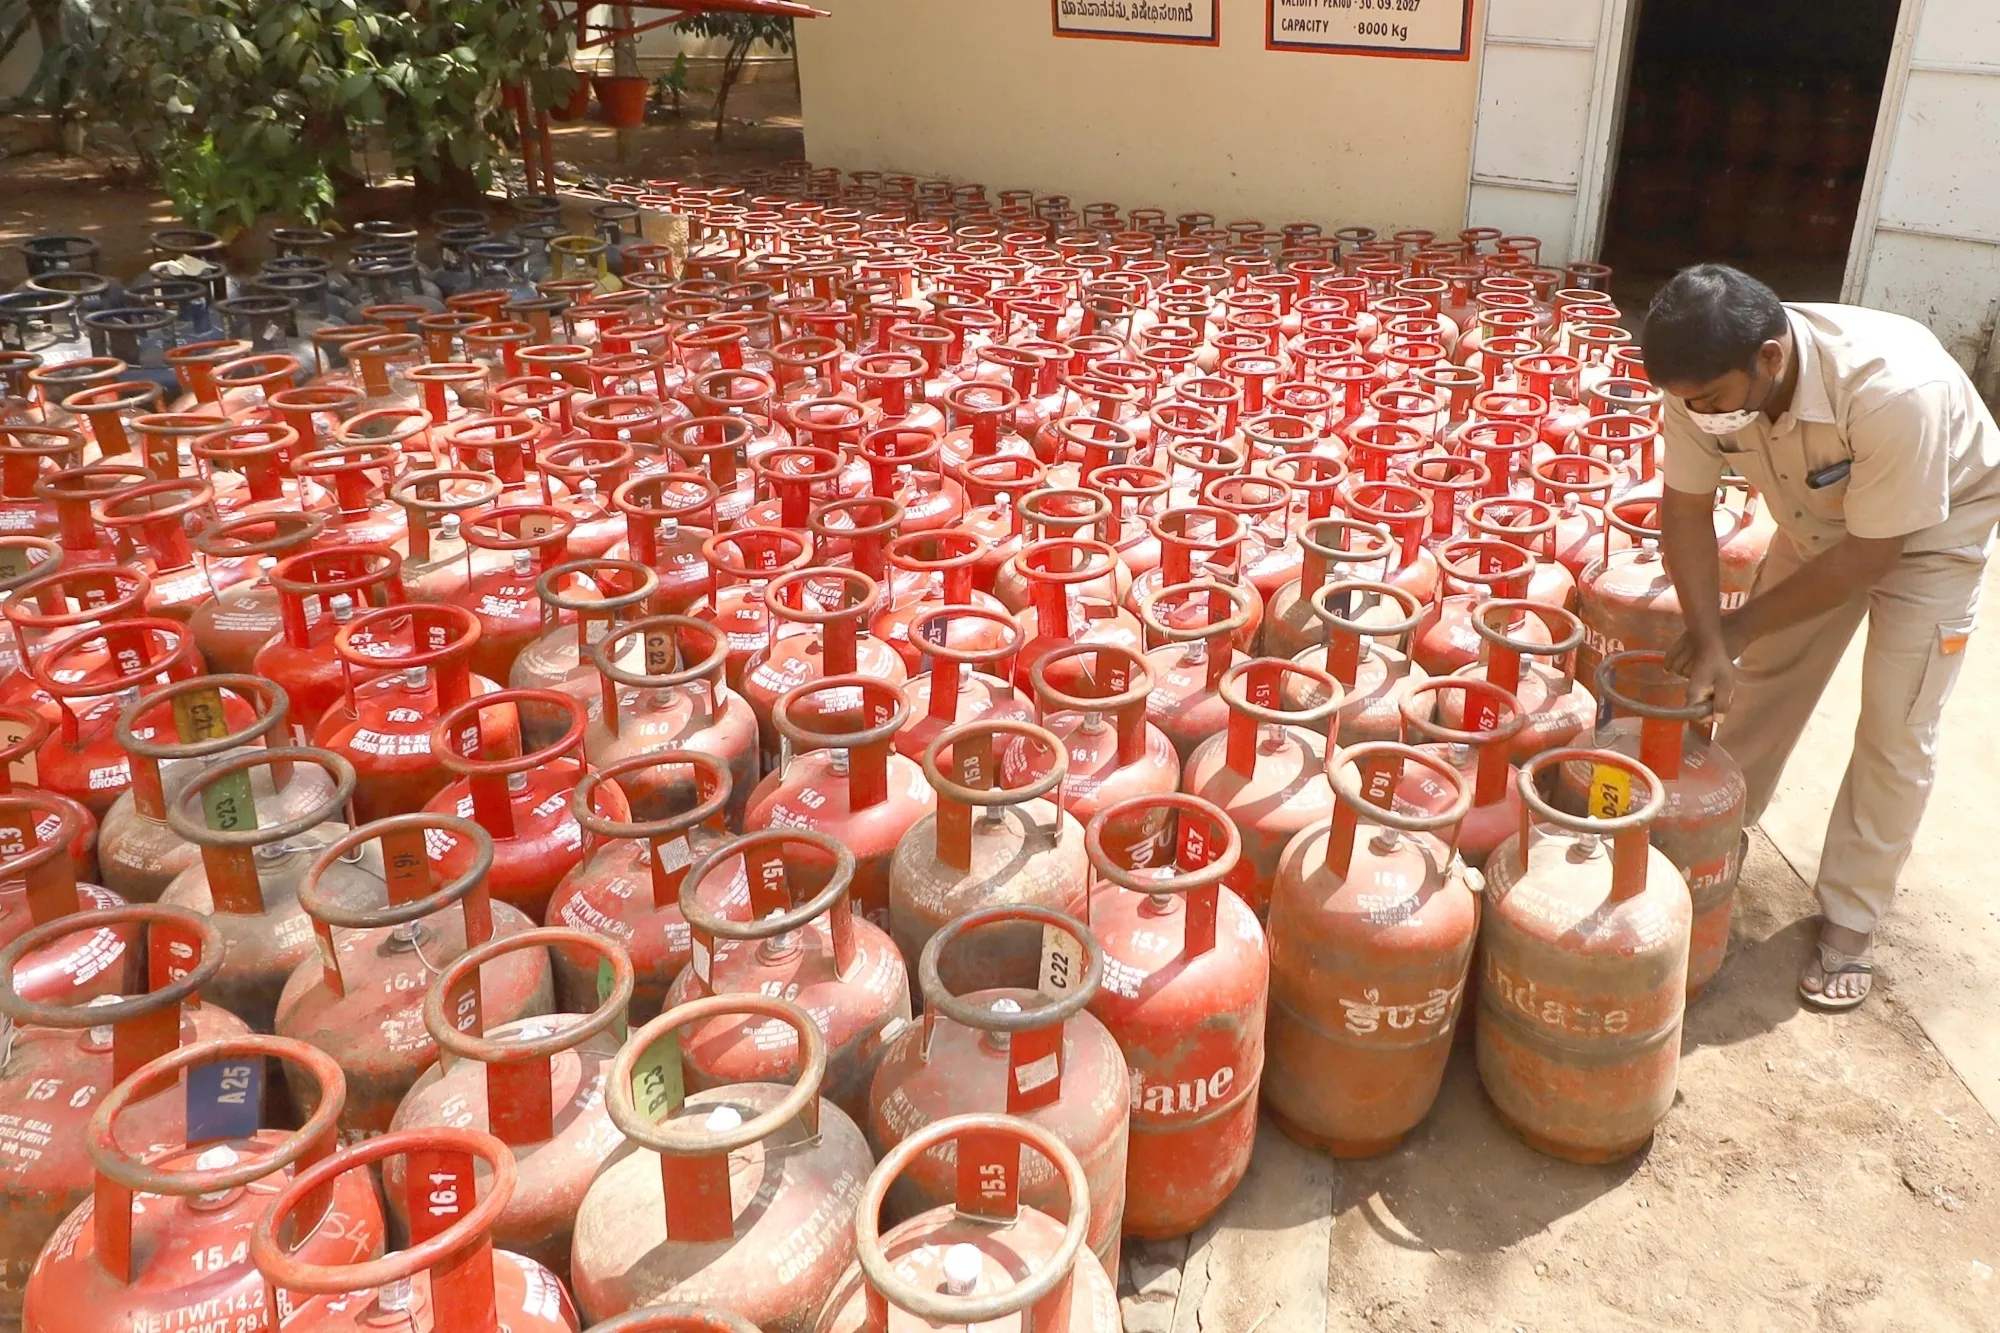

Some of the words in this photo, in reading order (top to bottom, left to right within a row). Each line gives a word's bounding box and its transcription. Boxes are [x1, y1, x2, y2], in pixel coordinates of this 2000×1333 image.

[1281, 18, 1329, 33] CAPACITY
[1391, 23, 1408, 42] Kg
[1110, 669, 1126, 692] 16.1
[1071, 748, 1099, 764] 16.1
[89, 775, 126, 790] GROSS
[963, 756, 987, 786] 15.8
[1368, 770, 1392, 798] 16.0
[1418, 778, 1447, 799] 15.7
[1186, 827, 1204, 861] 15.7
[605, 876, 638, 899] 15.5
[1050, 952, 1069, 989] C22
[760, 980, 799, 1004] 15.6
[217, 1065, 252, 1104] A25
[428, 1172, 459, 1216] 16.1
[979, 1164, 1006, 1199] 15.5
[191, 1240, 248, 1272] 15.4
